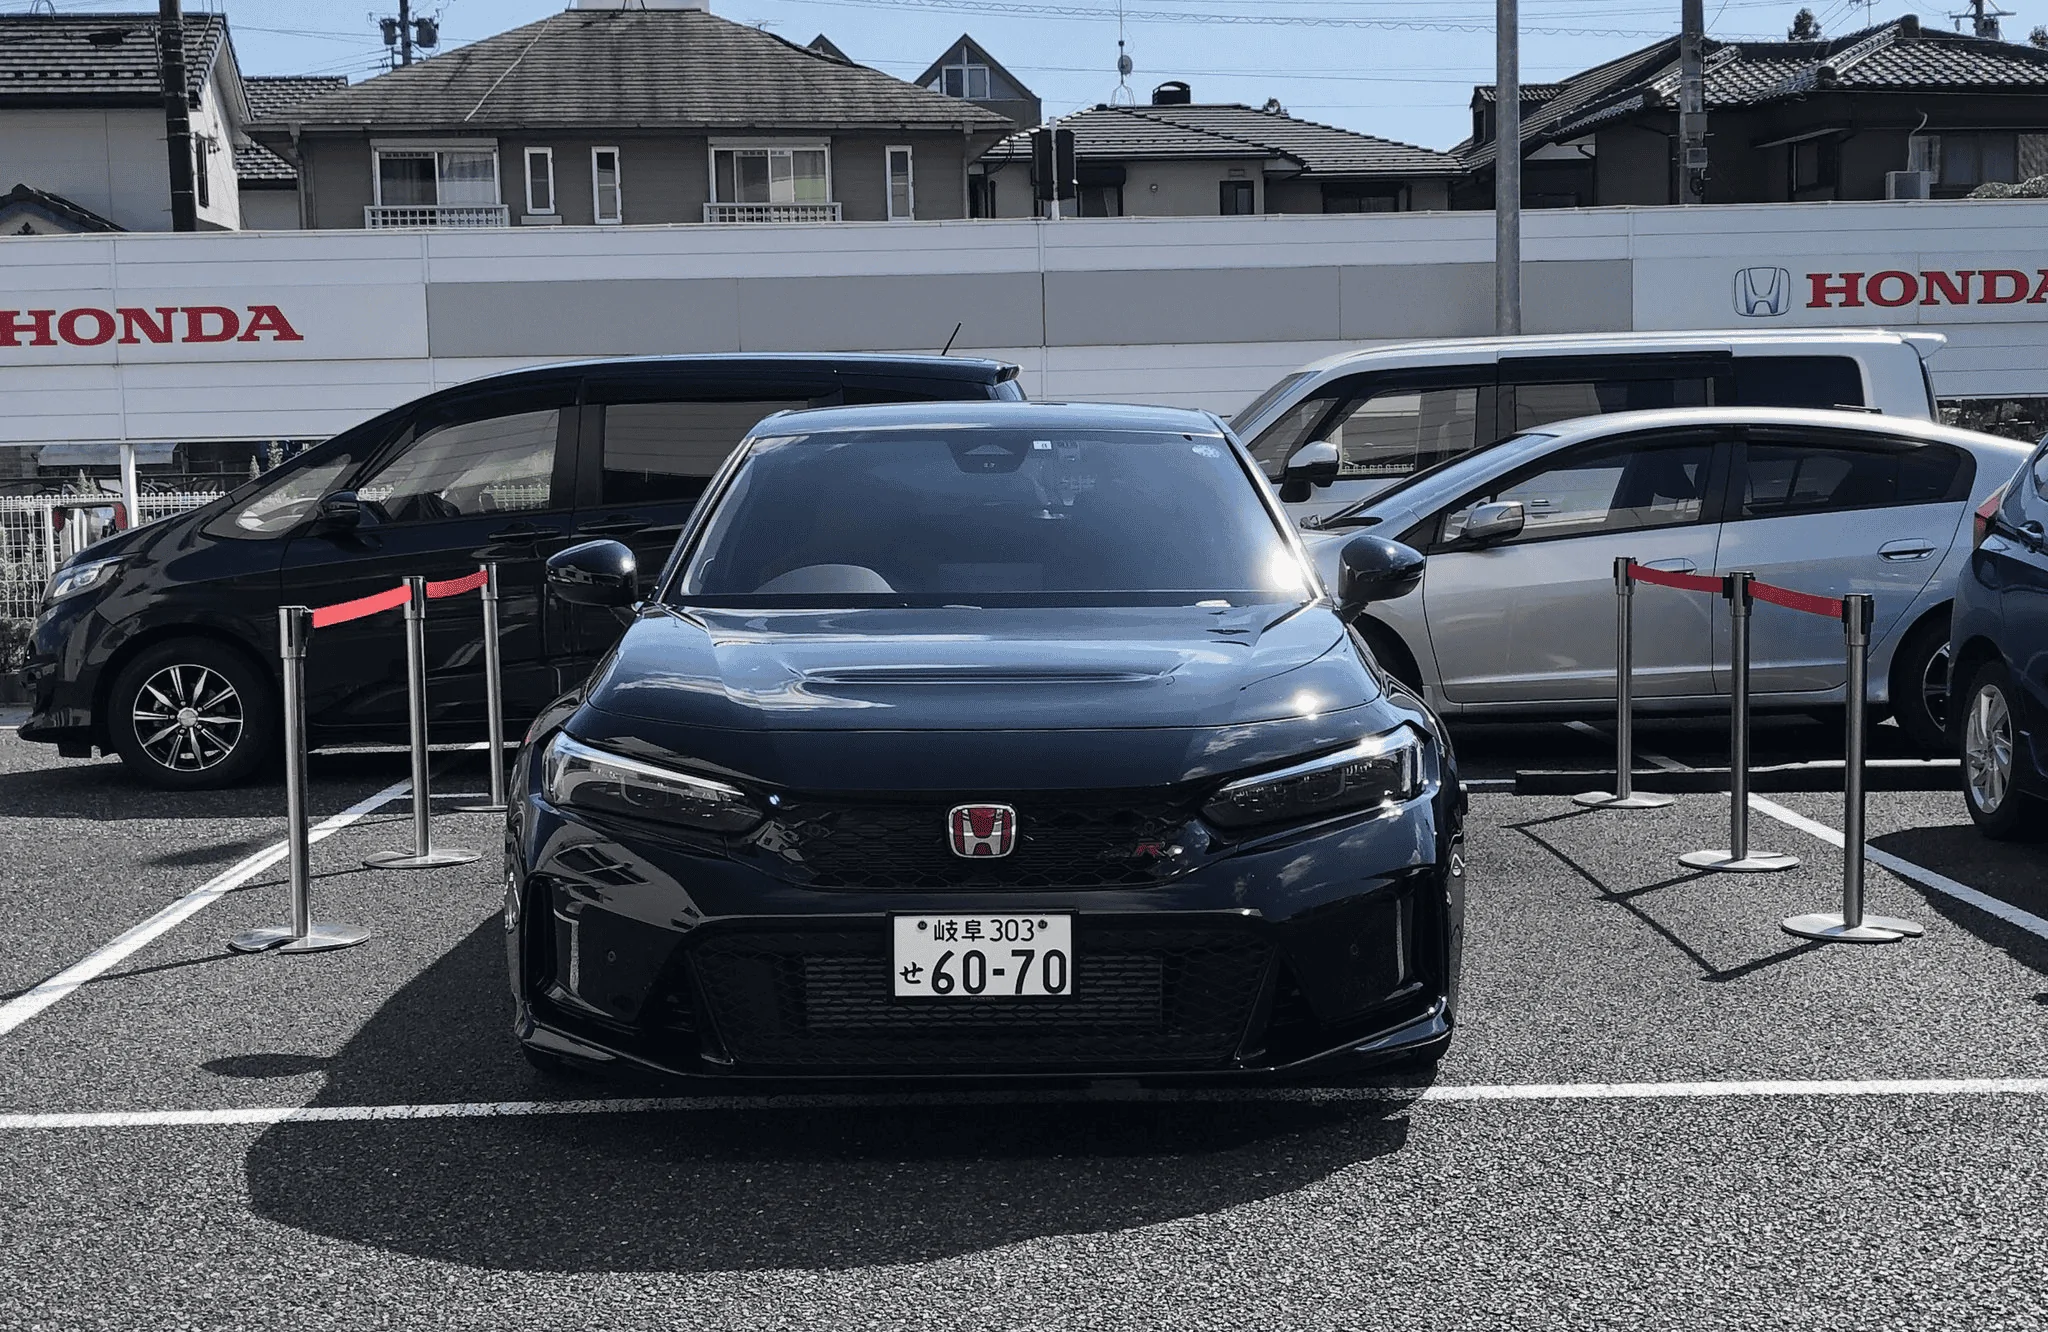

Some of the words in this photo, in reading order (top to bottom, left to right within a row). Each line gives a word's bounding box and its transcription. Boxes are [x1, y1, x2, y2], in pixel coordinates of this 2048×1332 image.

[0, 305, 304, 346] HONDA
[933, 919, 985, 942] 岐阜
[989, 918, 1035, 942] 303
[899, 961, 924, 984] せ
[931, 949, 1067, 995] 60-70
